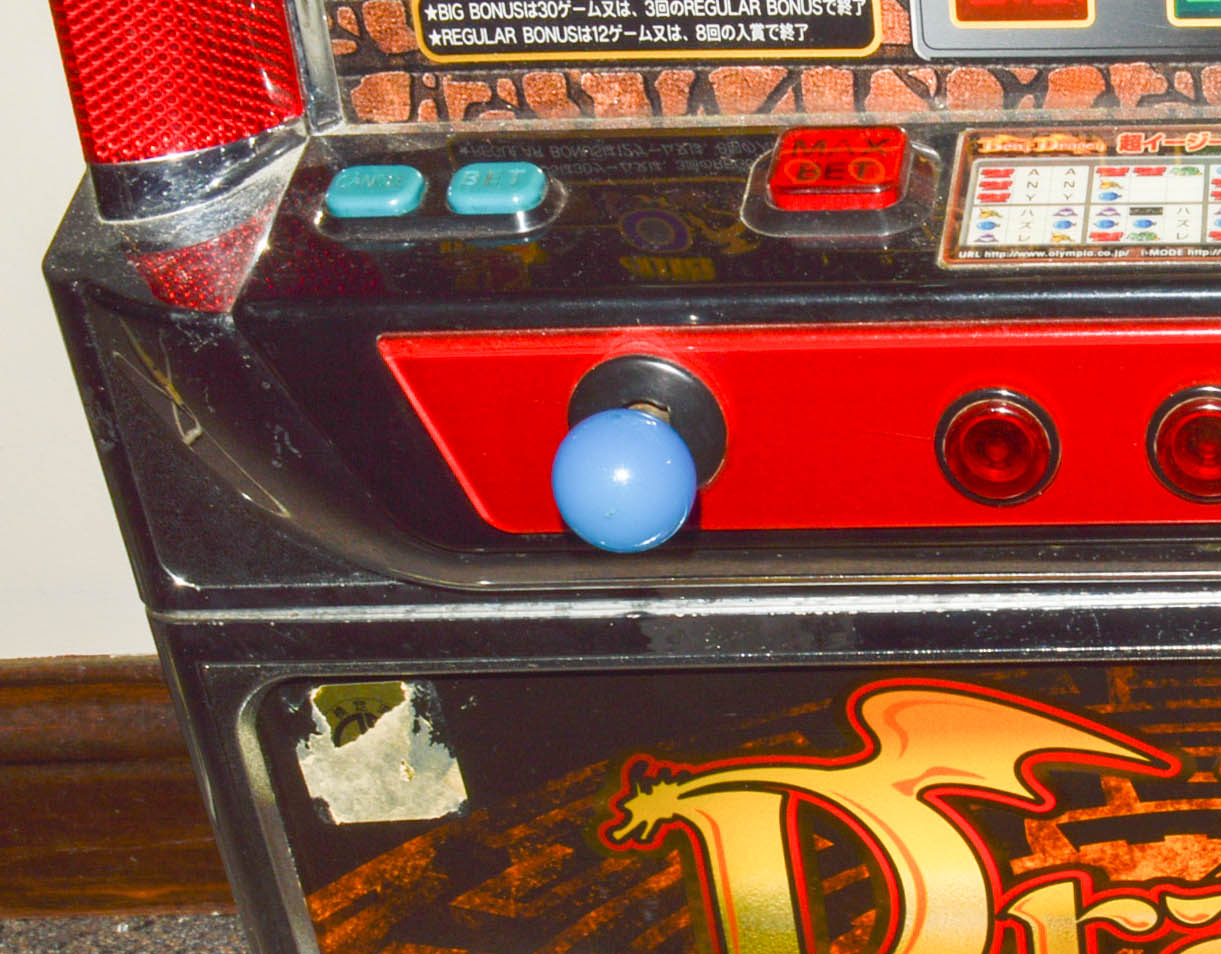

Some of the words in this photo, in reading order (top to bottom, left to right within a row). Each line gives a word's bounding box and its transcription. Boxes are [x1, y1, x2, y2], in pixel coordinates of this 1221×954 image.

[442, 26, 517, 46] REGULAR
[792, 138, 889, 157] MAX
[797, 161, 876, 181] BET
[958, 249, 981, 258] URL
